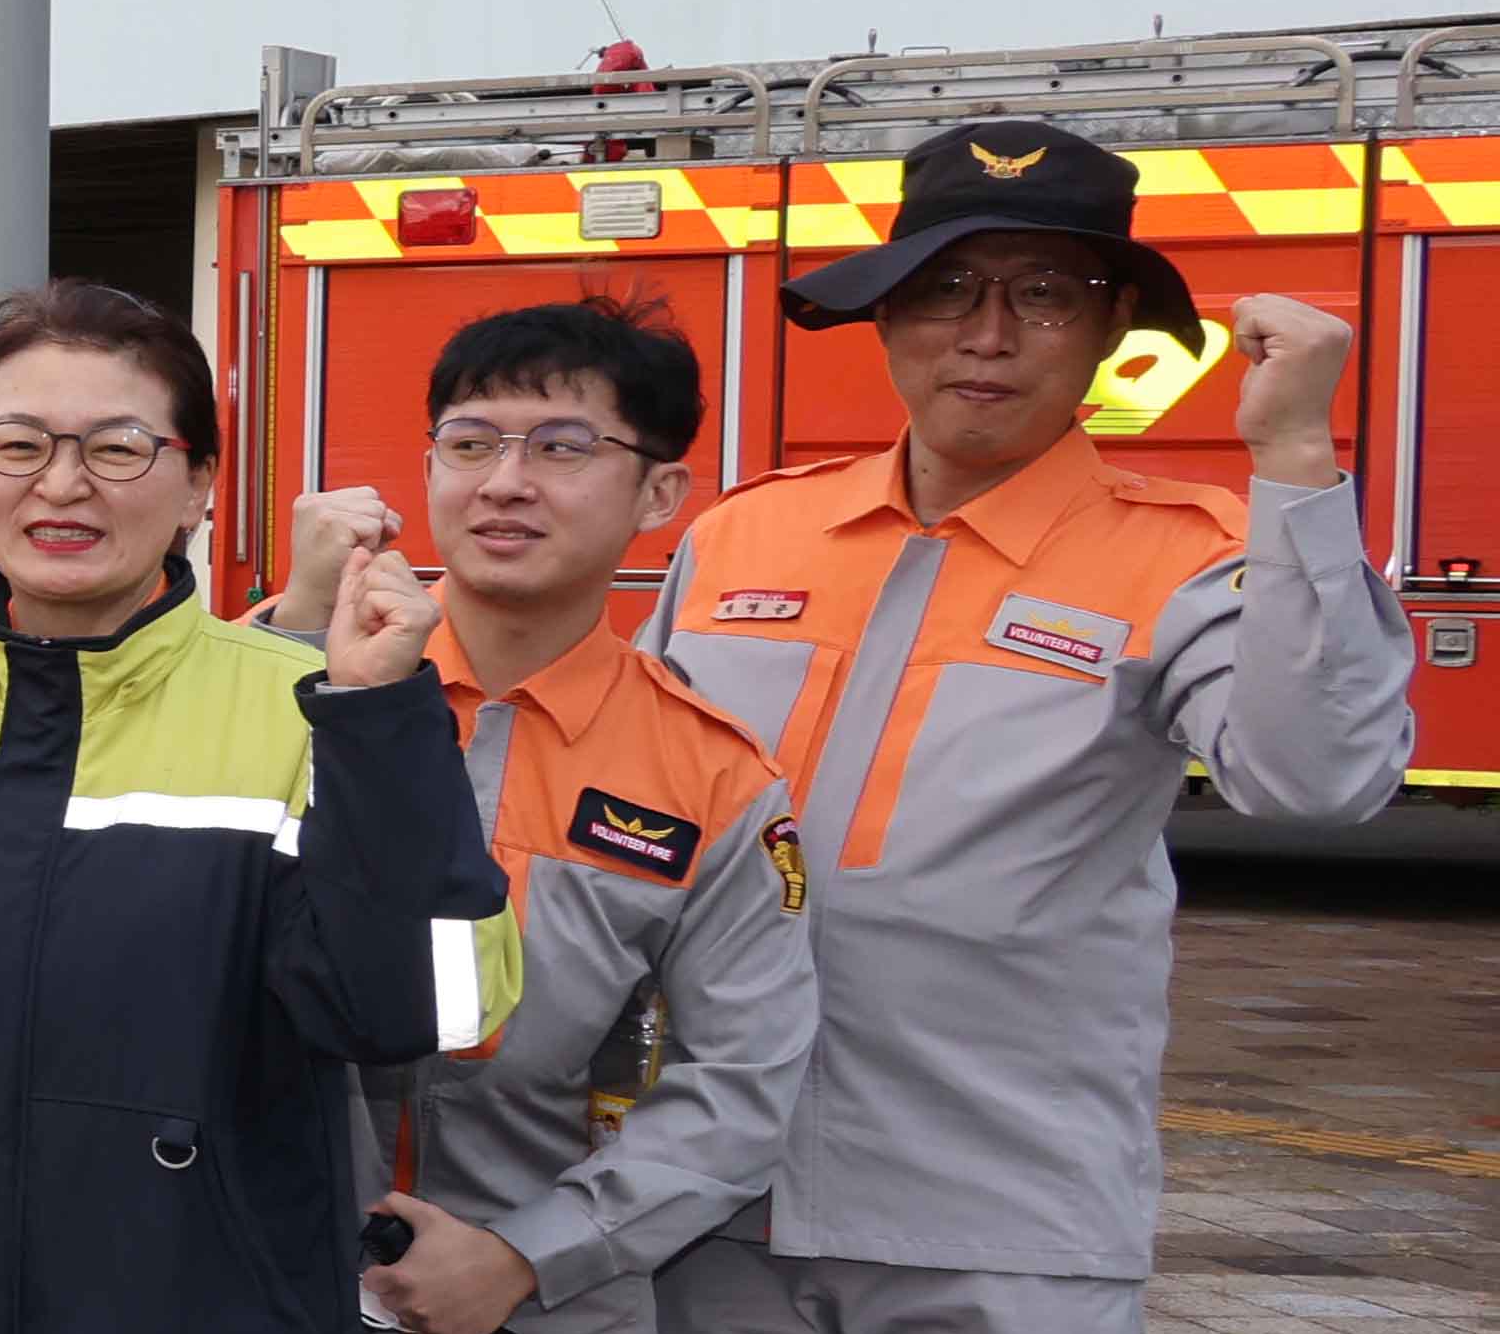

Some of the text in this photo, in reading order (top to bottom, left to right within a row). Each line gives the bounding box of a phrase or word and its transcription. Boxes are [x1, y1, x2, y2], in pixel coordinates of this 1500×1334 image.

[1009, 626, 1100, 660] VOLUNTEER FIRE
[590, 821, 674, 861] VOLUNTEER FIRE
